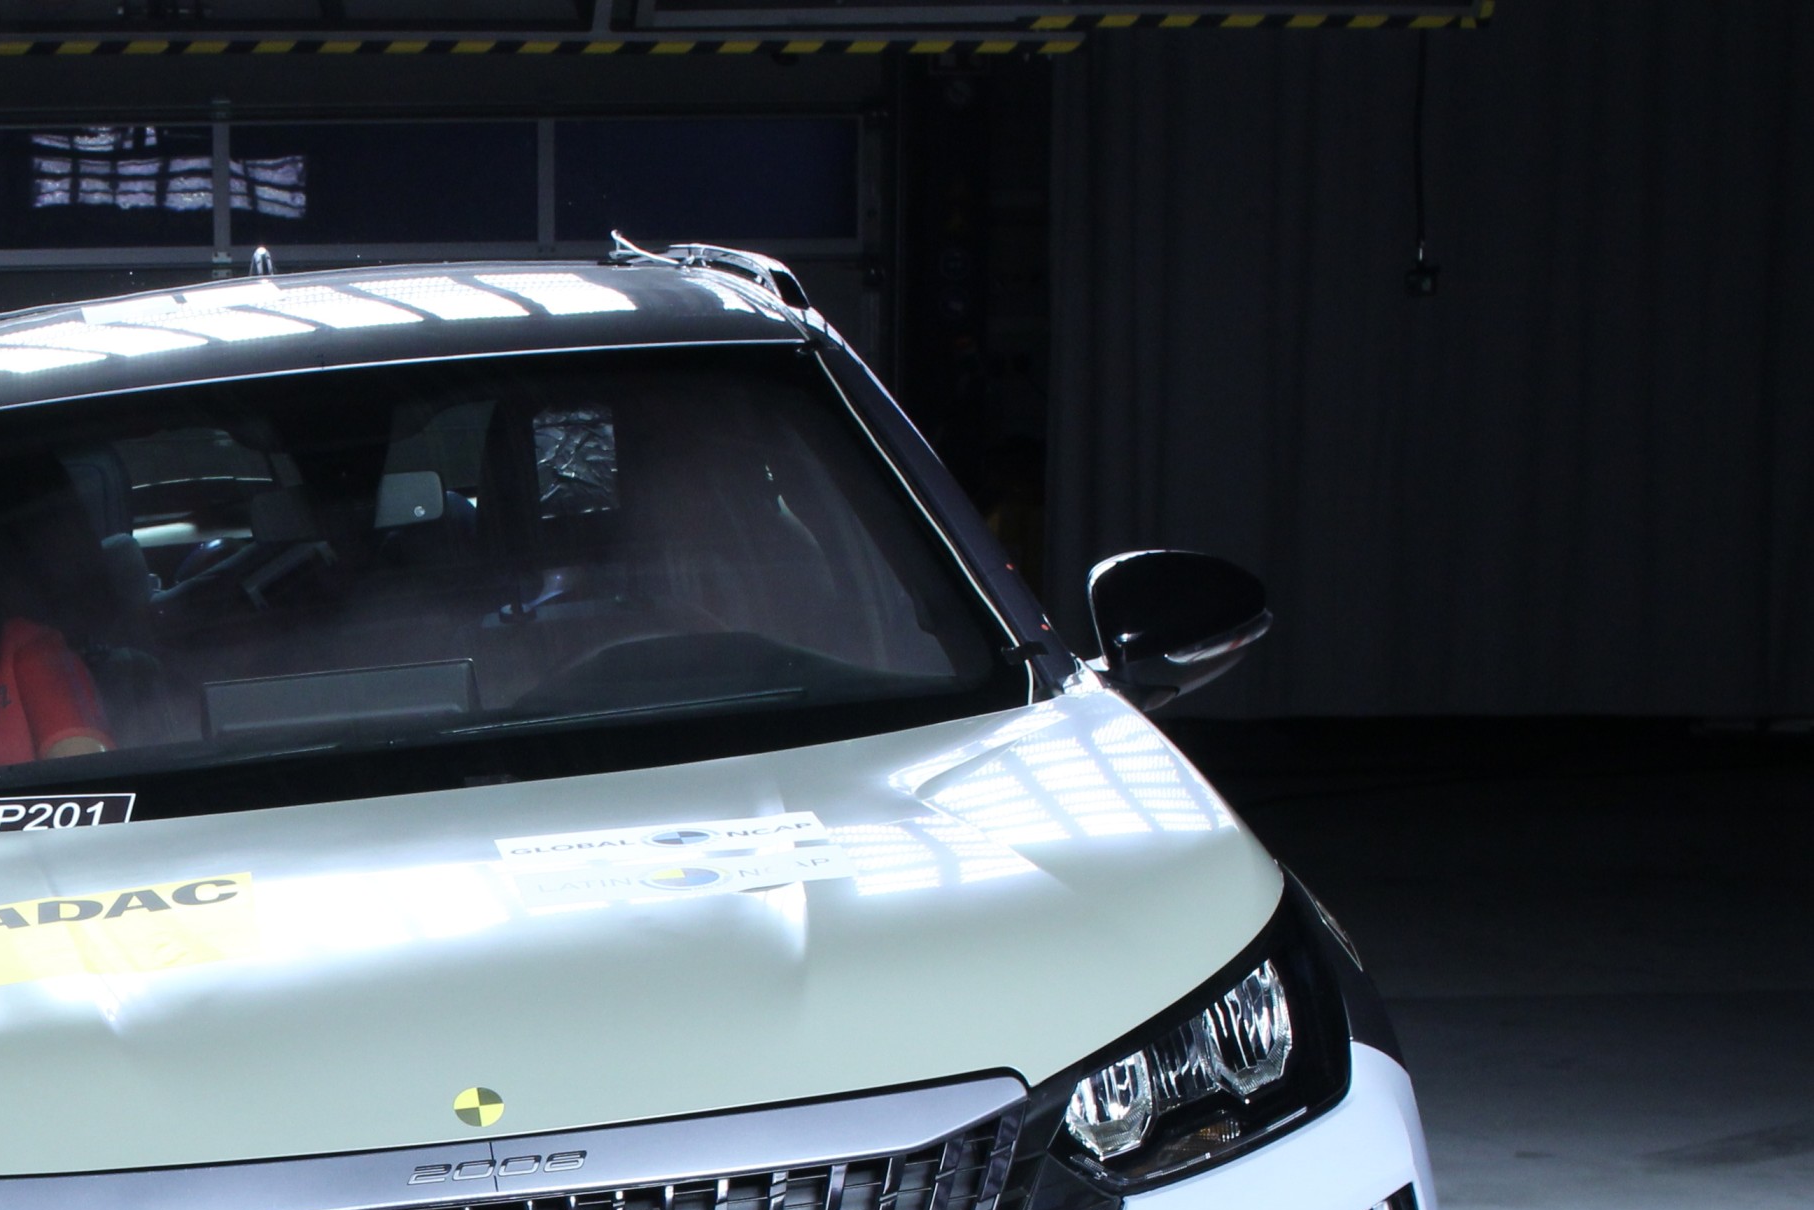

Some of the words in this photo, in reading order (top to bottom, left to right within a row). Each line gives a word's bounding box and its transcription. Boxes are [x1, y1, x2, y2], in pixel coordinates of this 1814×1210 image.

[510, 838, 637, 855] GLOBAL
[726, 821, 813, 837] NCAP
[537, 876, 632, 893] LATIN
[407, 1149, 588, 1186] 2008
